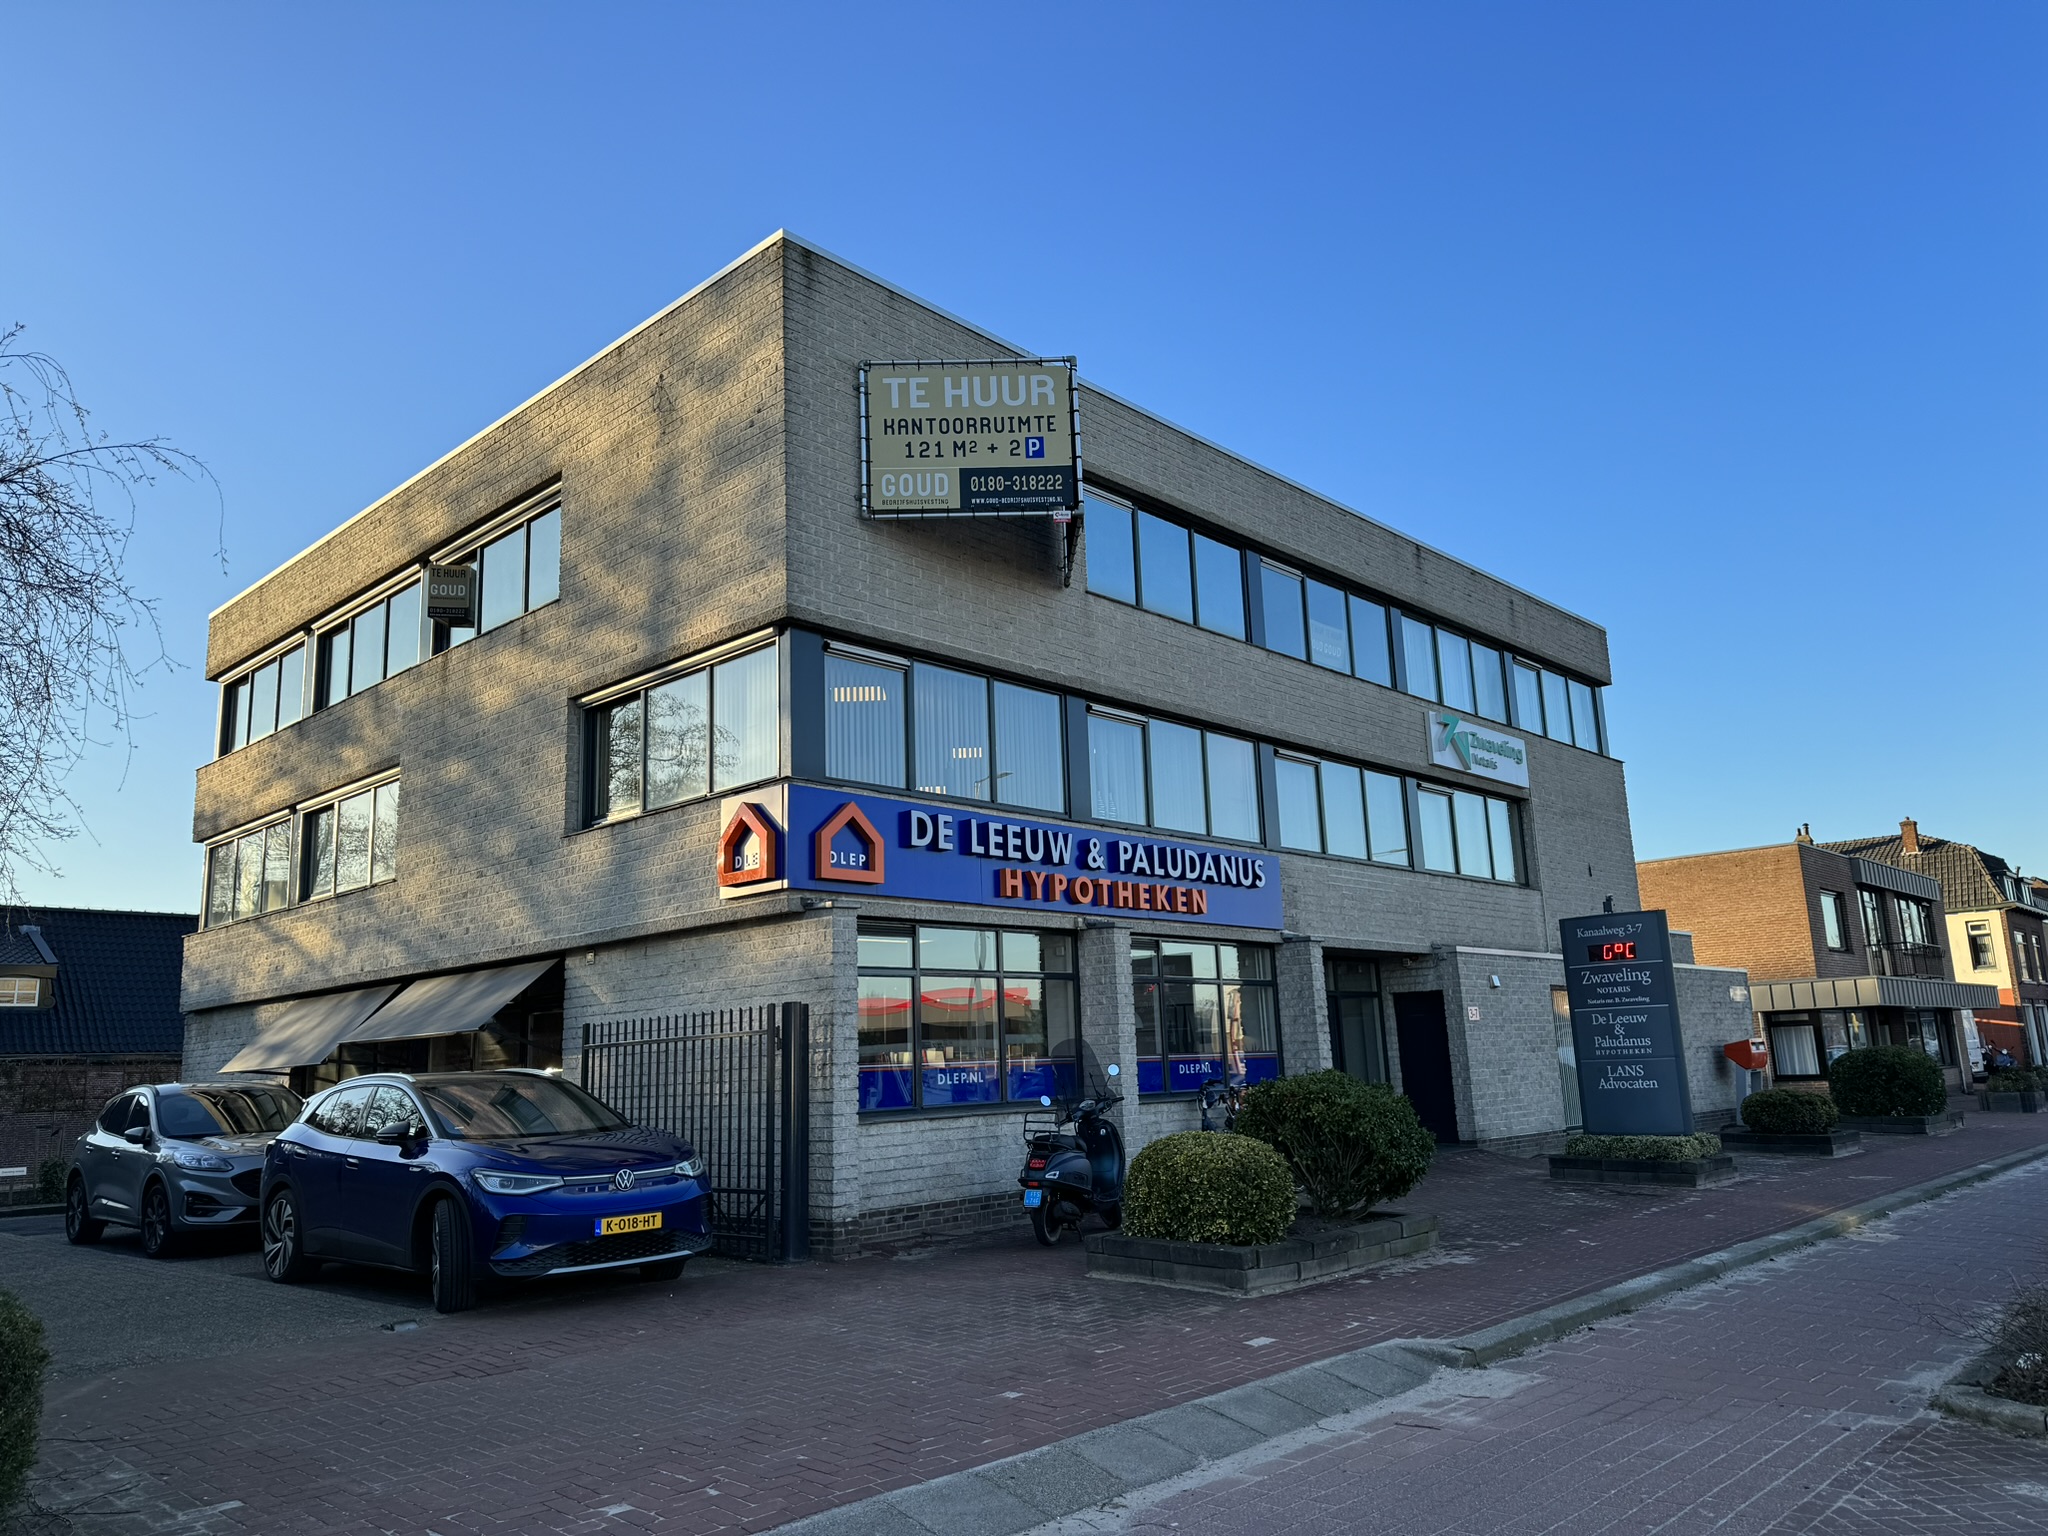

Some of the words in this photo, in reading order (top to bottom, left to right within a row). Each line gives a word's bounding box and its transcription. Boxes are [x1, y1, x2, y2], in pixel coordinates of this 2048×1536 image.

[882, 377, 930, 408] TE
[944, 375, 1055, 407] HUUR
[884, 415, 1056, 435] KANTOORRUIMTE
[905, 440, 944, 458] 121
[987, 443, 998, 454] +
[881, 473, 949, 497] GOUD
[970, 474, 1063, 491] 0180-318222
[431, 568, 442, 578] TE
[444, 569, 466, 579] HUUR
[430, 584, 466, 596] GOUD
[908, 809, 953, 851] DE
[969, 817, 1073, 866] LEEUW
[1086, 838, 1106, 871] &
[1118, 840, 1267, 889] PALUDANUS
[830, 850, 866, 866] DLEP
[1002, 867, 1209, 915] HYPOTHEKEN
[1577, 925, 1625, 938] Kanaalweg
[1626, 923, 1643, 935] 3-7
[1581, 967, 1652, 985] Zwaveling
[1596, 985, 1631, 994] NOTARIS
[1592, 1013, 1607, 1025] De
[1608, 1013, 1648, 1024] Leeuw
[1614, 1024, 1625, 1035] &
[1594, 1035, 1652, 1048] Paludanus
[1595, 1047, 1653, 1056] HYPOTHEKEN
[1178, 1062, 1213, 1074] DLEP.NL
[1606, 1065, 1644, 1077] LANS
[937, 1071, 984, 1085] DLEP.NL
[1599, 1078, 1659, 1089] Advocaten
[606, 1215, 657, 1232] K-018-HT
